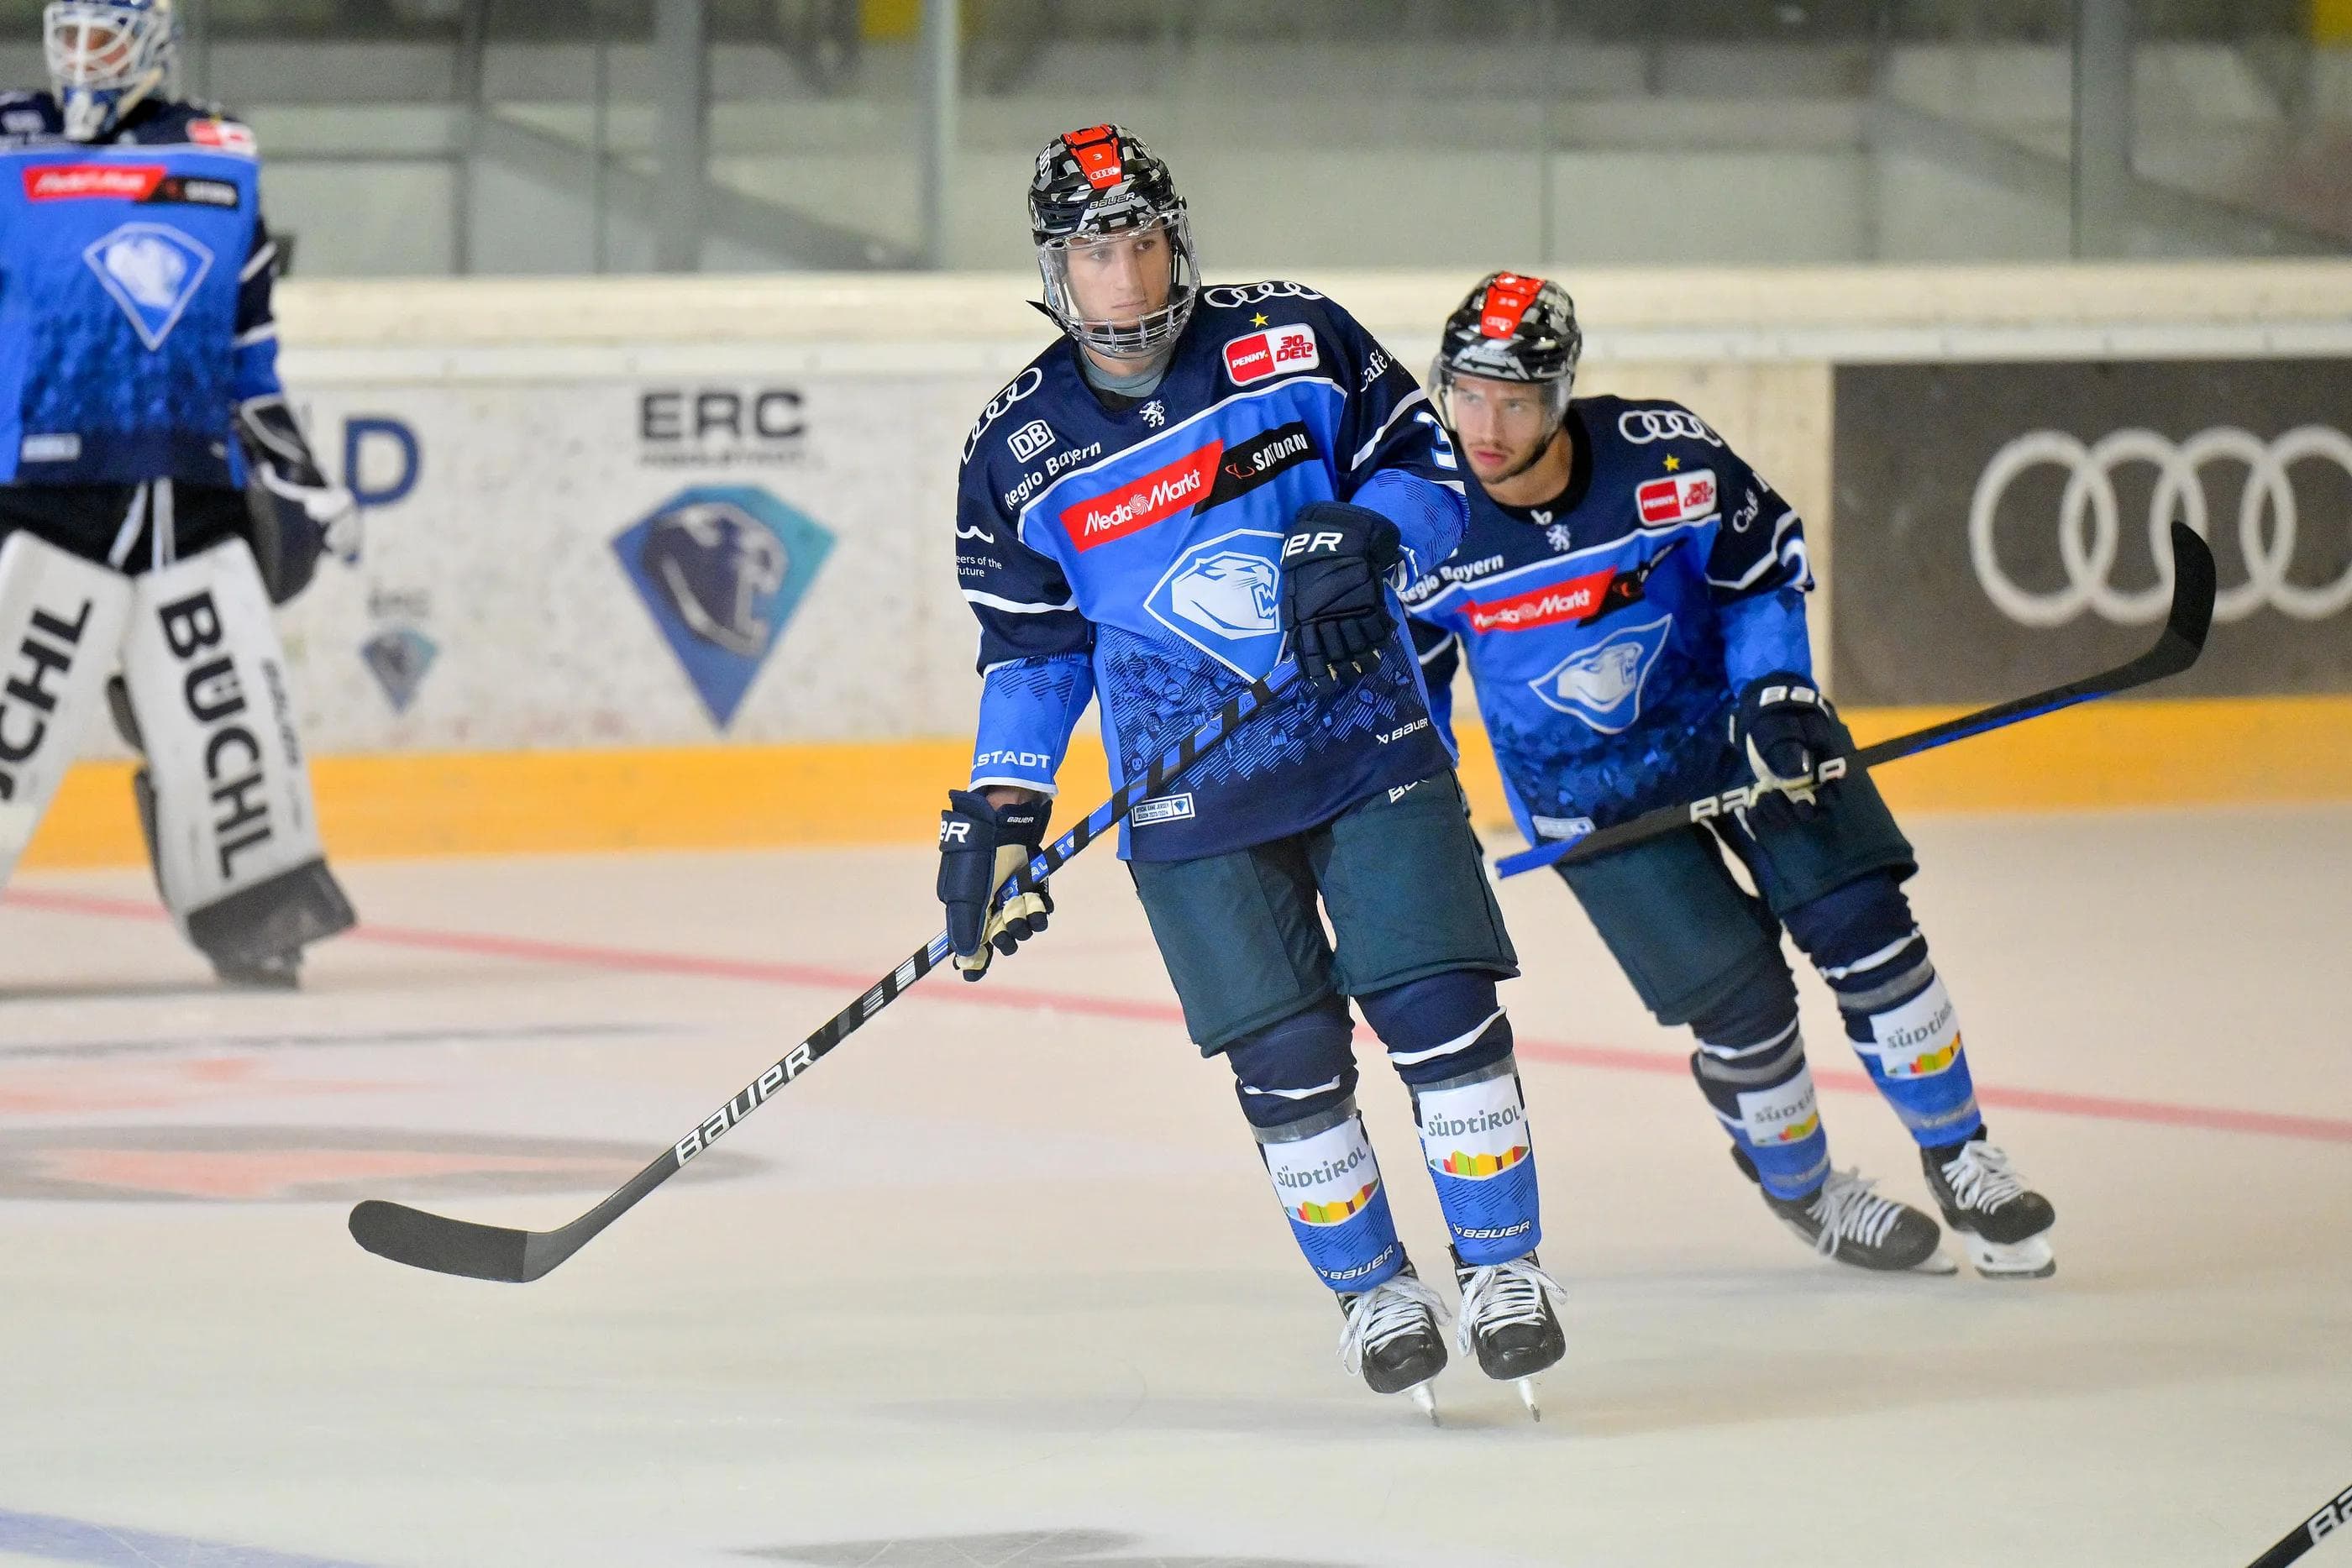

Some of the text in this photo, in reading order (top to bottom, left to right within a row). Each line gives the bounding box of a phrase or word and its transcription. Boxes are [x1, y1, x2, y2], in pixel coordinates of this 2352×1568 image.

[1280, 334, 1304, 349] 30
[639, 389, 806, 439] ERC
[1012, 422, 1048, 457] DB
[1252, 433, 1308, 471] SATURN
[1045, 442, 1101, 476] Bayern
[977, 557, 986, 566] of
[988, 558, 1002, 570] the
[1440, 554, 1504, 582] Bayern
[157, 590, 274, 879] BÜCHL
